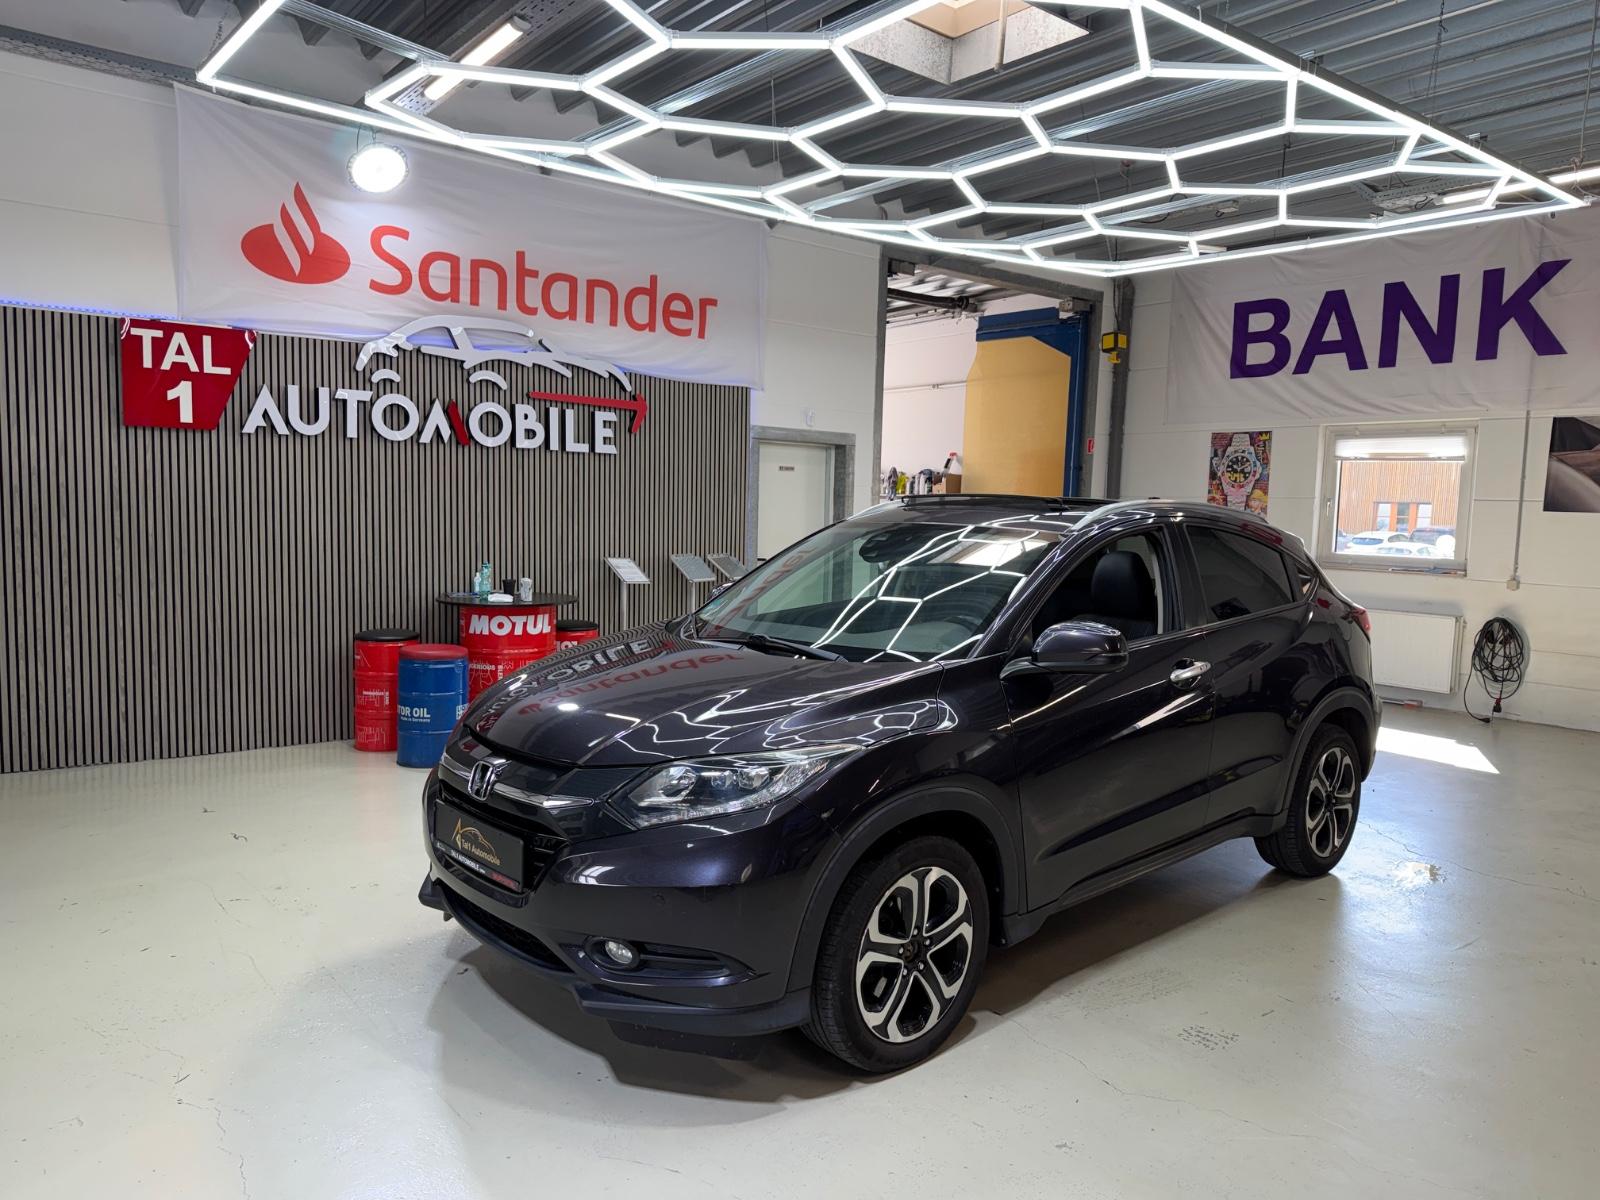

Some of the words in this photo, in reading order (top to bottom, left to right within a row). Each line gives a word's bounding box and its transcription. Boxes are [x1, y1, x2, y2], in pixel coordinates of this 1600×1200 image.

[369, 225, 718, 339] Santander
[1230, 259, 1572, 379] BANK
[130, 327, 231, 375] TAL
[166, 380, 193, 424] 1
[242, 384, 618, 455] AUTOMOBILE
[468, 614, 551, 635] MOTUL
[412, 707, 431, 718] OIL
